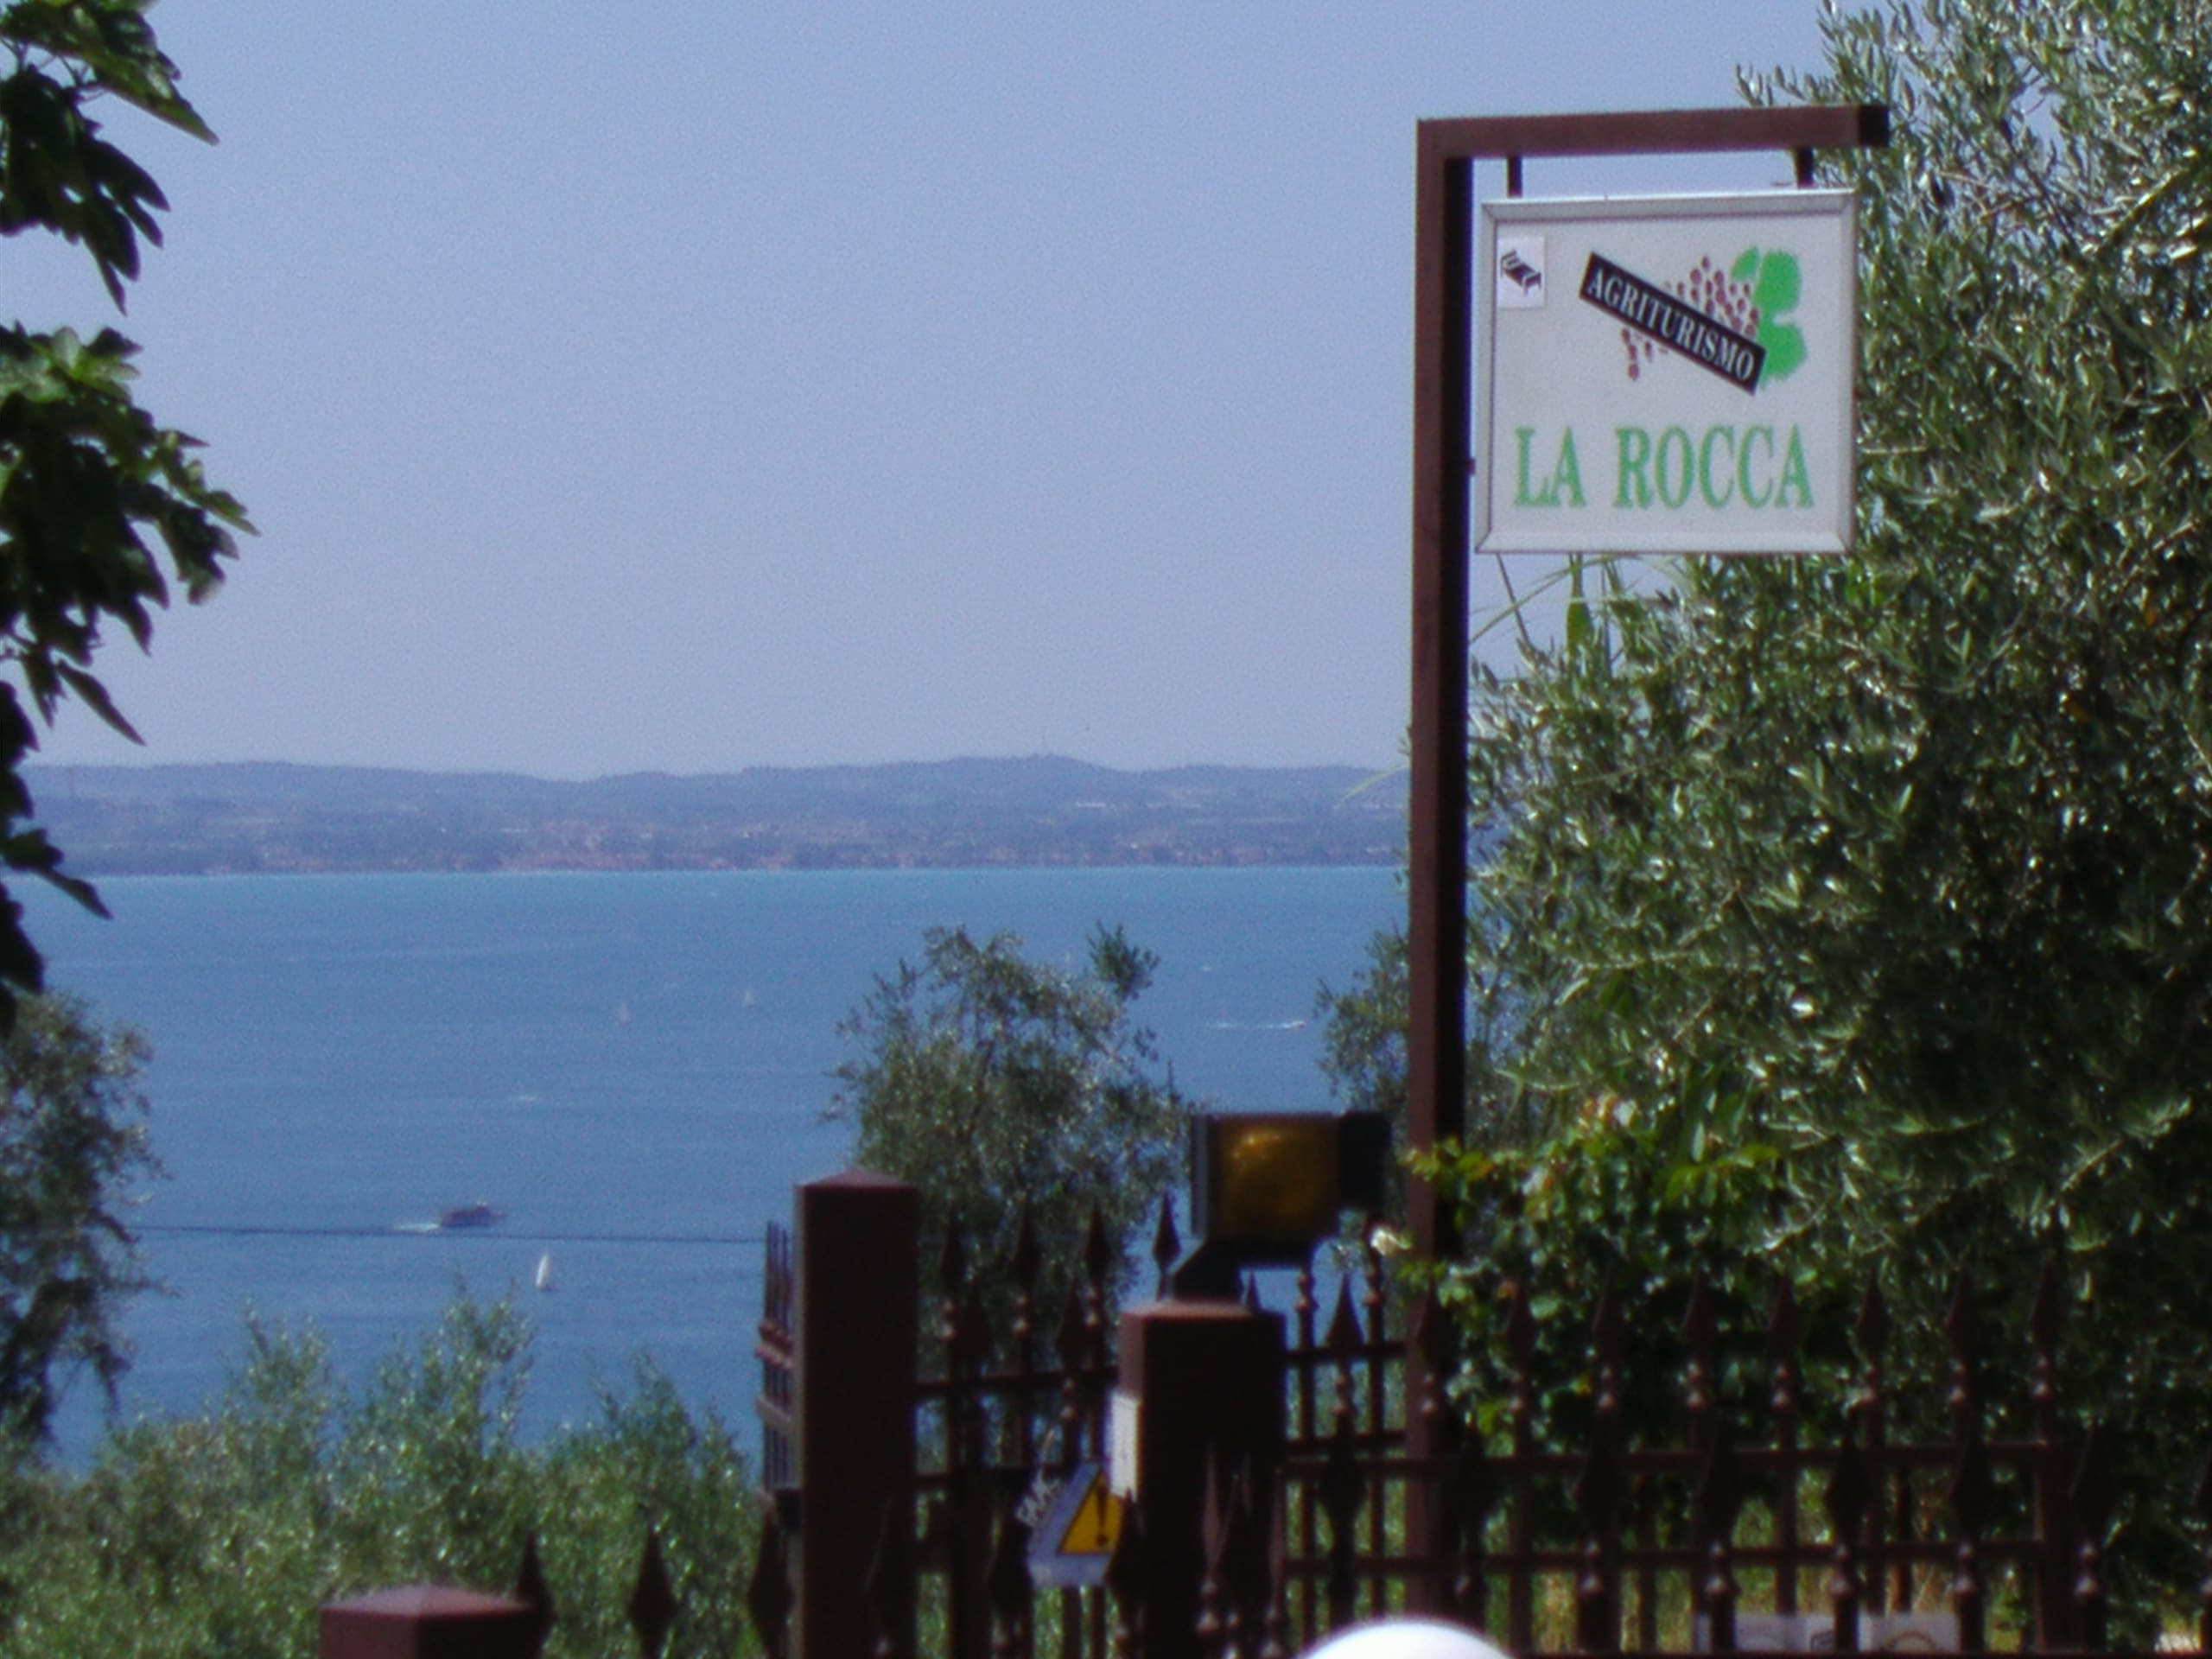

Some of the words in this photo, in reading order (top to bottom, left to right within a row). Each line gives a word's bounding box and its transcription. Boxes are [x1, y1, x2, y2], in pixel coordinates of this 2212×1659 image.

[1586, 270, 1755, 381] AGRITURISMO
[1516, 427, 1584, 506] LA
[1614, 426, 1814, 507] ROCCA
